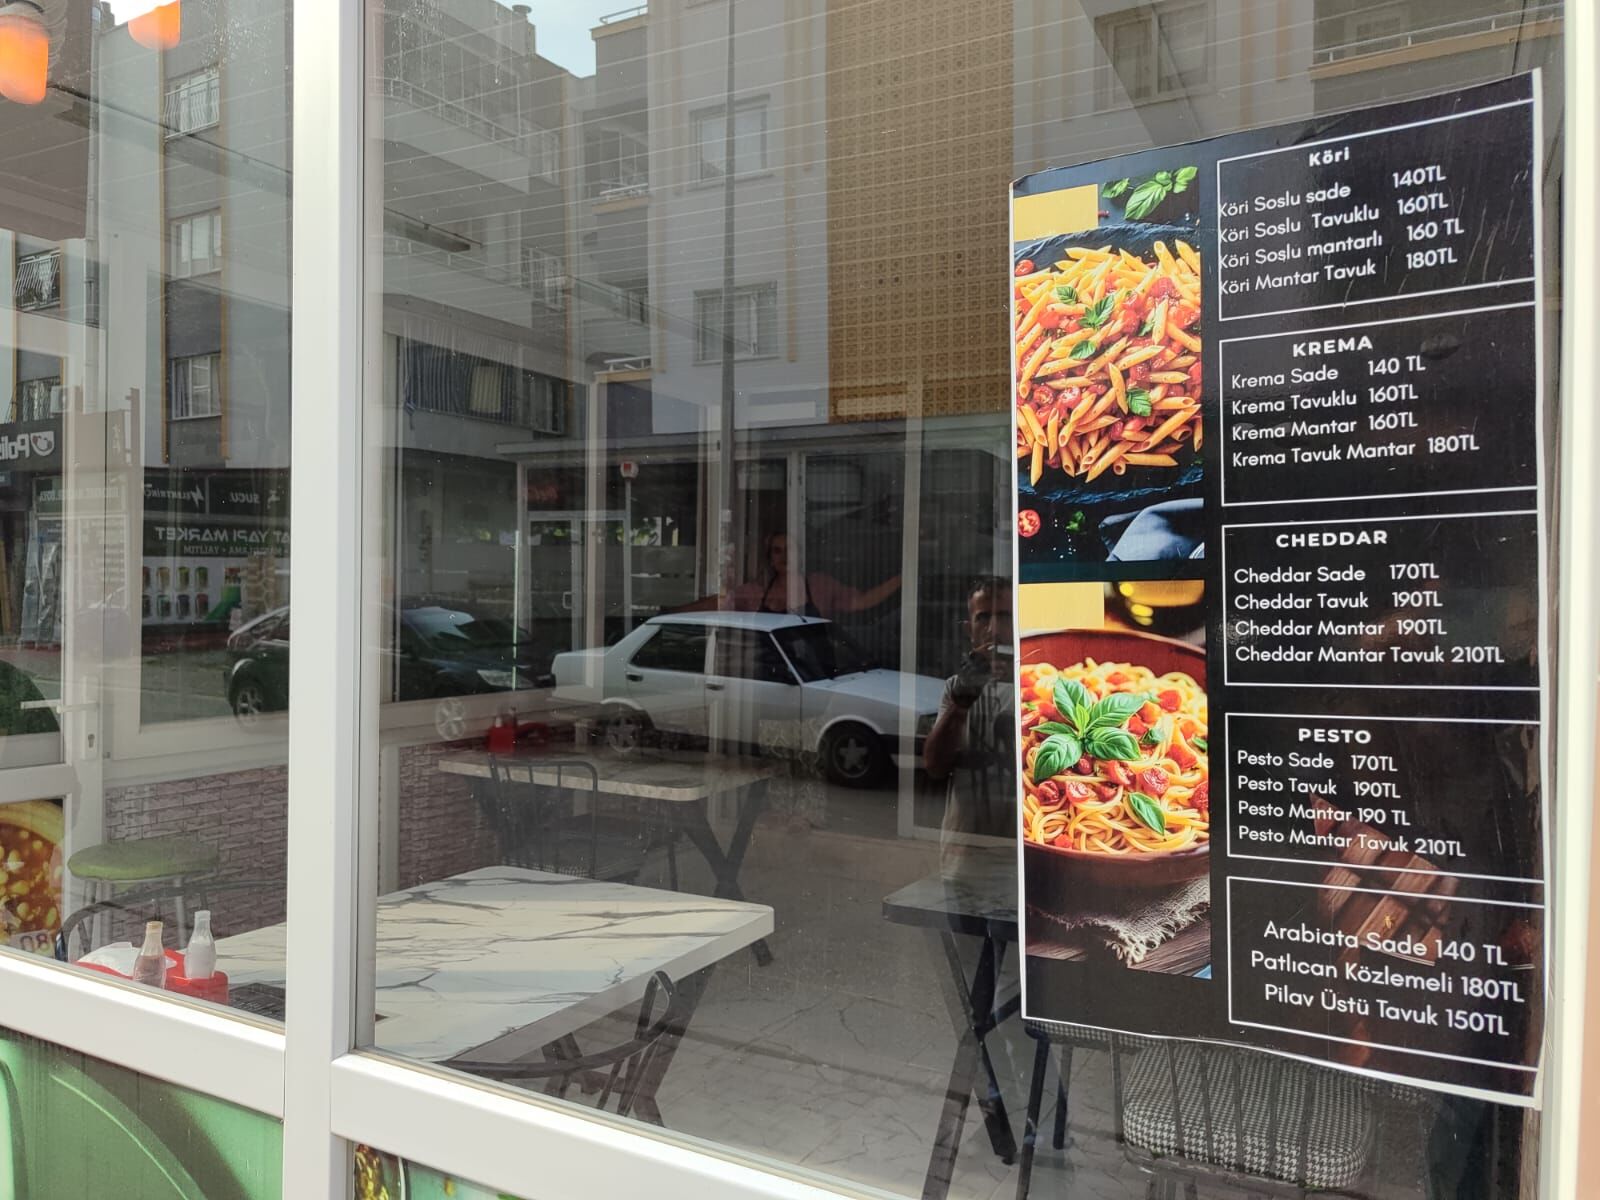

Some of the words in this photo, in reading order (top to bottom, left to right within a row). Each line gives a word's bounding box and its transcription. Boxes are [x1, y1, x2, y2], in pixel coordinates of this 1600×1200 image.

[1309, 147, 1350, 167] Köri
[1219, 201, 1249, 218] Köri
[1254, 191, 1301, 213] Soslu
[1306, 183, 1351, 203] sade
[1392, 165, 1447, 188] 140TL
[1219, 226, 1249, 243] Köri
[1255, 217, 1301, 239] Soslu
[1312, 205, 1379, 228] Tavuklu
[1397, 192, 1449, 215] 160TL
[1219, 252, 1249, 269] Köri
[1255, 244, 1301, 264] Soslu
[1307, 232, 1383, 257] mantarlı
[1407, 222, 1438, 241] 160
[1442, 218, 1464, 235] TL
[1219, 278, 1250, 295] Köri
[1255, 271, 1321, 290] Mantar
[1324, 259, 1377, 281] Tavuk
[1406, 248, 1458, 269] 180TL
[1292, 336, 1373, 357] KREMA
[1231, 372, 1285, 389] Krema
[1291, 365, 1339, 384] Sade
[1368, 358, 1400, 376] 140
[1406, 356, 1426, 371] TL
[1232, 399, 1285, 415] Krema
[1291, 390, 1357, 410] Tavuklu
[1368, 384, 1419, 403] 160TL
[1232, 426, 1285, 441] Krema
[1291, 419, 1357, 437] Mantar
[1368, 412, 1418, 430] 160TL
[1233, 452, 1285, 467] Krema
[1292, 445, 1342, 464] Tavuk
[1347, 442, 1416, 459] Mantar
[1427, 435, 1480, 453] 180TL
[1275, 530, 1388, 548] CHEDDAR
[1234, 567, 1312, 584] Cheddar
[1316, 565, 1366, 582] Sade
[1389, 563, 1440, 580] 170TL
[1234, 594, 1312, 610] Cheddar
[1317, 592, 1369, 608] Tavuk
[1392, 591, 1443, 608] 190TL
[1235, 620, 1313, 636] Cheddar
[1318, 621, 1385, 635] Mantar
[1396, 619, 1447, 635] 190TL
[1235, 646, 1314, 662] Cheddar
[1318, 647, 1386, 662] Mantar
[1390, 646, 1444, 663] Tavuk
[1450, 646, 1505, 664] 210TL
[1298, 728, 1372, 744] PESTO
[1237, 750, 1283, 767] Pesto
[1288, 752, 1334, 769] Sade
[1351, 755, 1398, 772] 170TL
[1238, 775, 1284, 792] Pesto
[1288, 778, 1337, 795] Tavuk
[1354, 781, 1401, 798] 190TL
[1238, 801, 1284, 817] Pesto
[1289, 803, 1352, 822] Mantar
[1357, 807, 1386, 824] 190
[1391, 810, 1411, 826] TL
[1239, 826, 1284, 843] Pesto
[1289, 829, 1352, 848] Mantar
[1357, 833, 1409, 853] Tavuk
[1414, 838, 1466, 857] 210TL
[1264, 920, 1359, 949] Arabiata
[1366, 932, 1427, 957] Sade
[1435, 939, 1475, 962] 140
[1482, 944, 1508, 966] TL
[1251, 950, 1338, 979] Patlıcan
[1345, 962, 1453, 994] Közlemeli
[1461, 976, 1525, 1003] 180TL
[1265, 983, 1314, 1007] Pilav
[1321, 988, 1369, 1016] Üstü
[1376, 999, 1439, 1026] Tavuk
[1446, 1008, 1510, 1036] 150TL
